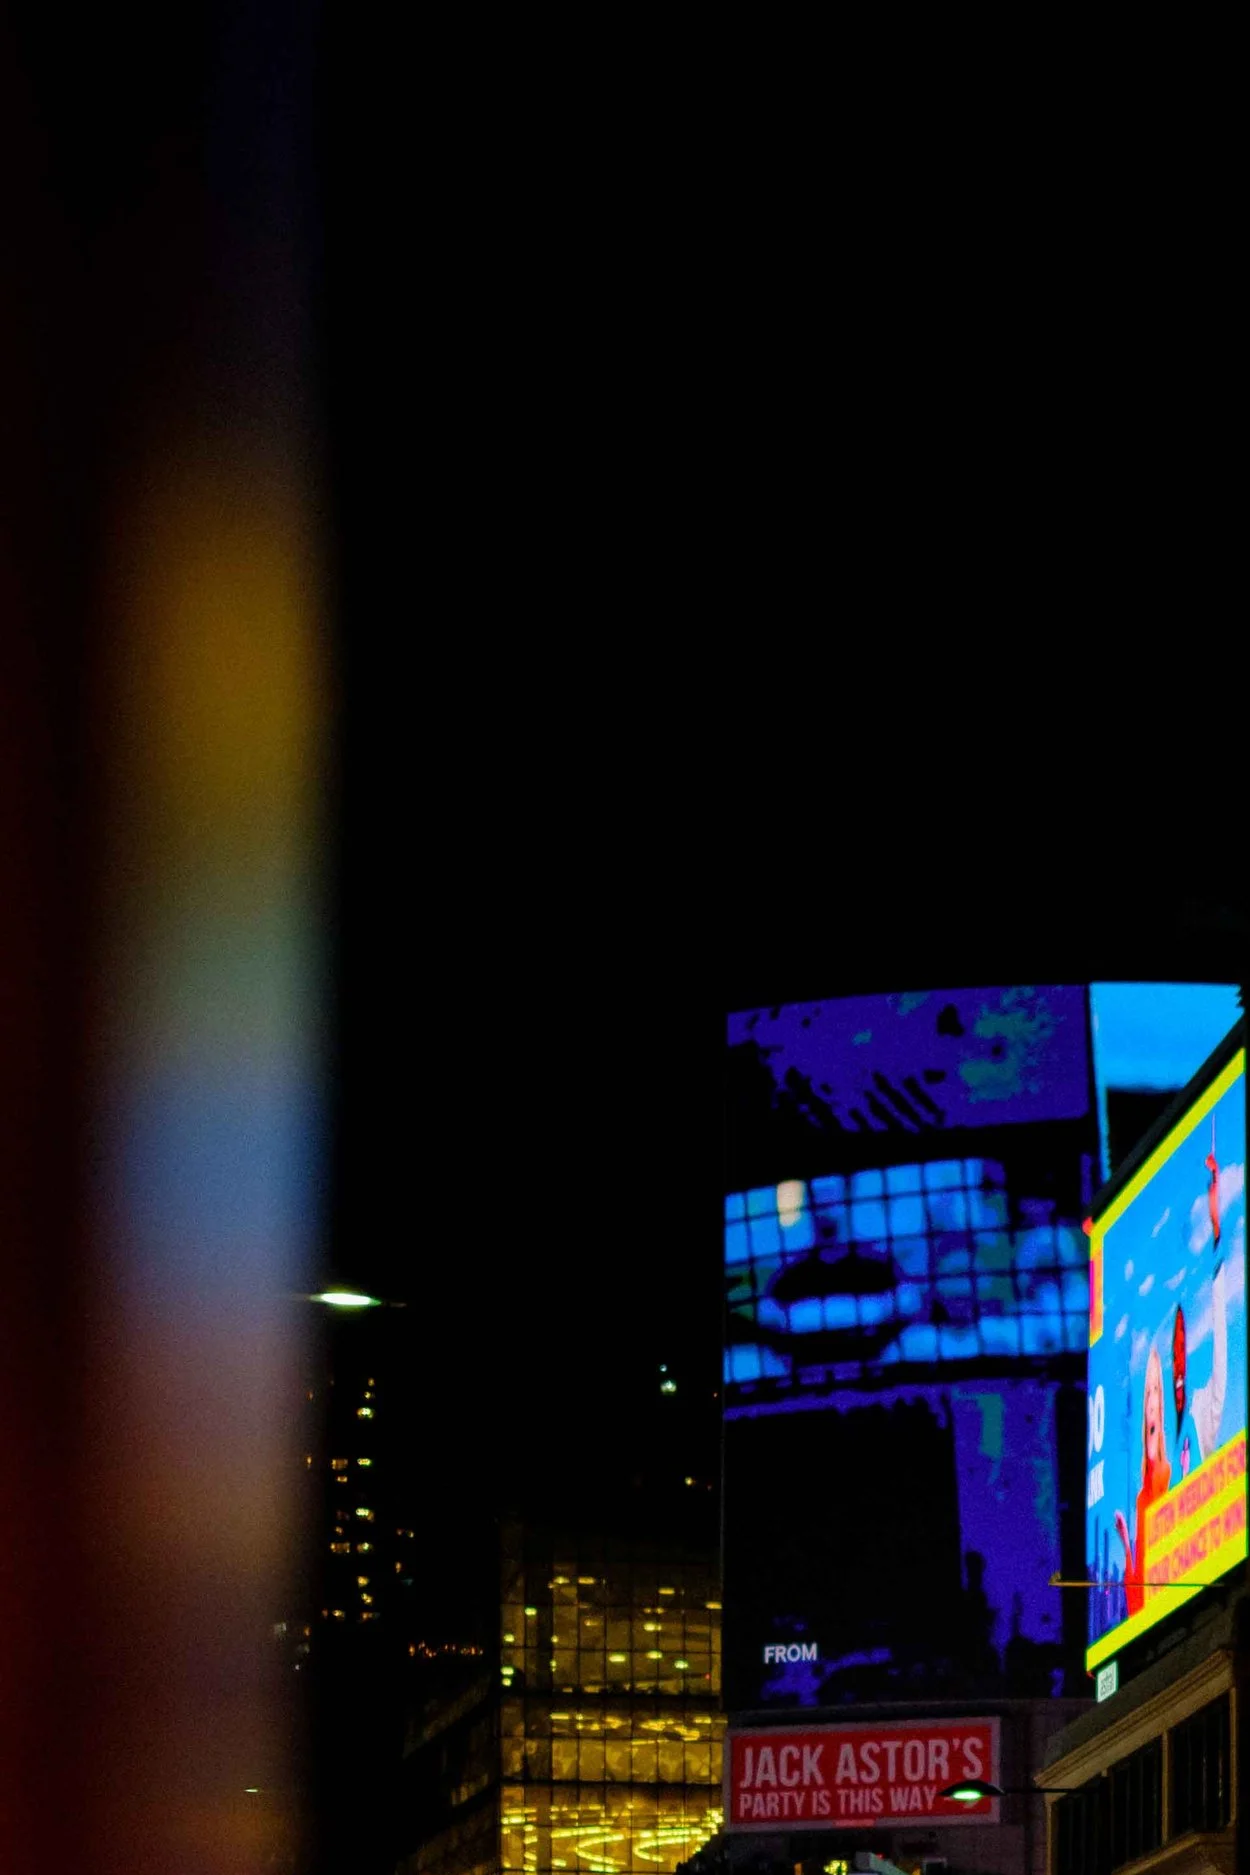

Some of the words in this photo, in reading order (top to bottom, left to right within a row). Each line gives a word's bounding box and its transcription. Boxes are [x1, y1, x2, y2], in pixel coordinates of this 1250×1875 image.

[764, 1643, 818, 1664] FROM
[739, 1743, 825, 1789] JACK
[835, 1736, 983, 1786] ASTOR'S
[739, 1789, 806, 1818] PARTY
[811, 1788, 831, 1816] IS
[837, 1786, 884, 1814] THIS
[889, 1785, 938, 1813] WAY
